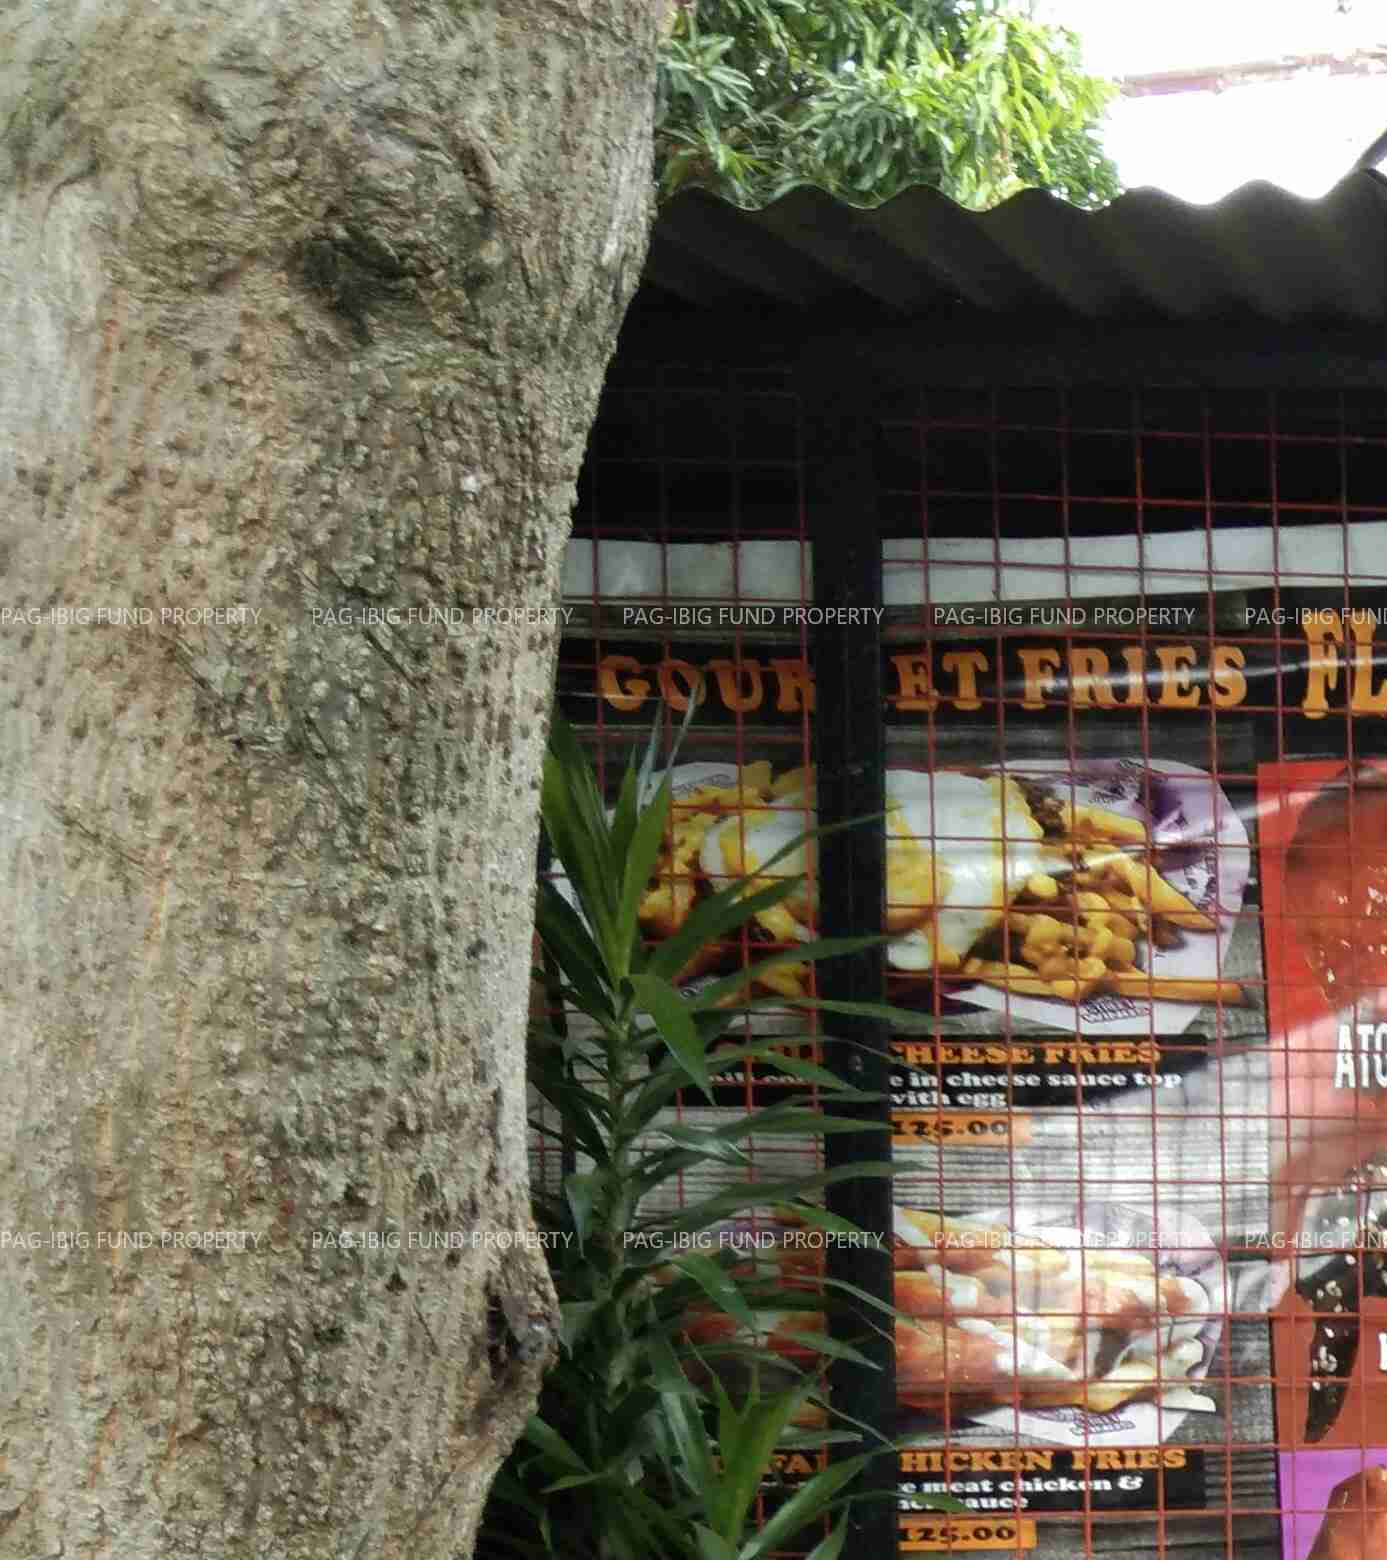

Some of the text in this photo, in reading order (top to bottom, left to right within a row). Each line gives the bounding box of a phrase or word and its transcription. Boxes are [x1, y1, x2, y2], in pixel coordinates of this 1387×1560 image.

[600, 645, 1249, 712] GOURET FRIES
[889, 1041, 1034, 1064] HEESE
[909, 1072, 938, 1087] in
[946, 1072, 1041, 1087] cheese
[1047, 1073, 1127, 1087] sauce
[1133, 1071, 1182, 1089] top
[901, 1449, 1187, 1472] HICKEN FRIES
[922, 1478, 994, 1494] meat
[1001, 1477, 1112, 1493] chicken
[962, 1496, 1029, 1509] auce
